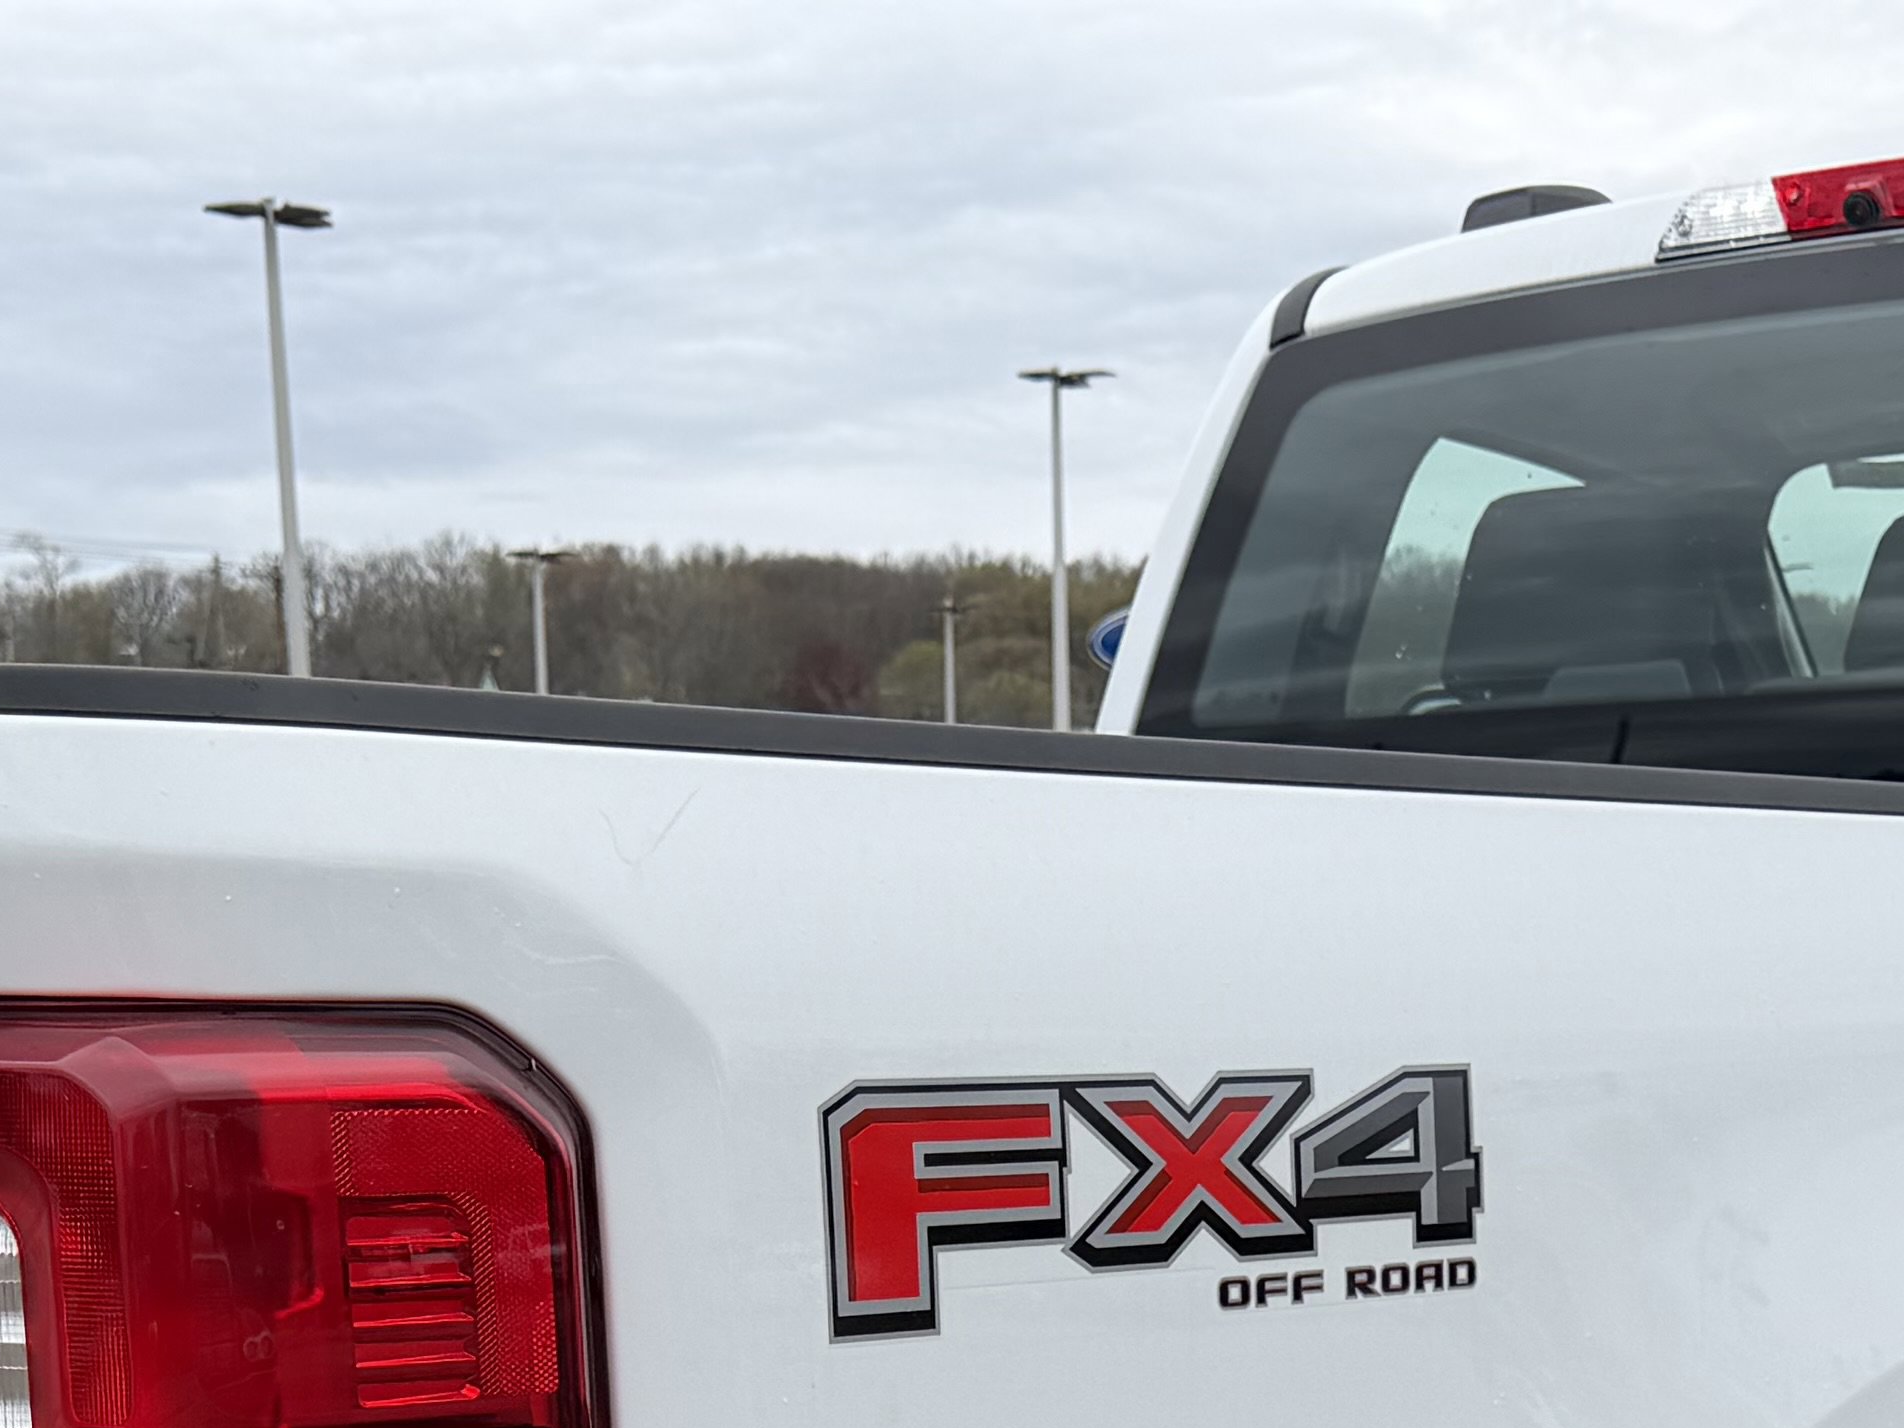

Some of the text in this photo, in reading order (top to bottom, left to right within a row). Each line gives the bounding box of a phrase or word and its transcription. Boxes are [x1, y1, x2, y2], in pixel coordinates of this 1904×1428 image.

[817, 1064, 1485, 1344] FX4
[1217, 1256, 1477, 1311] OFF ROAD
